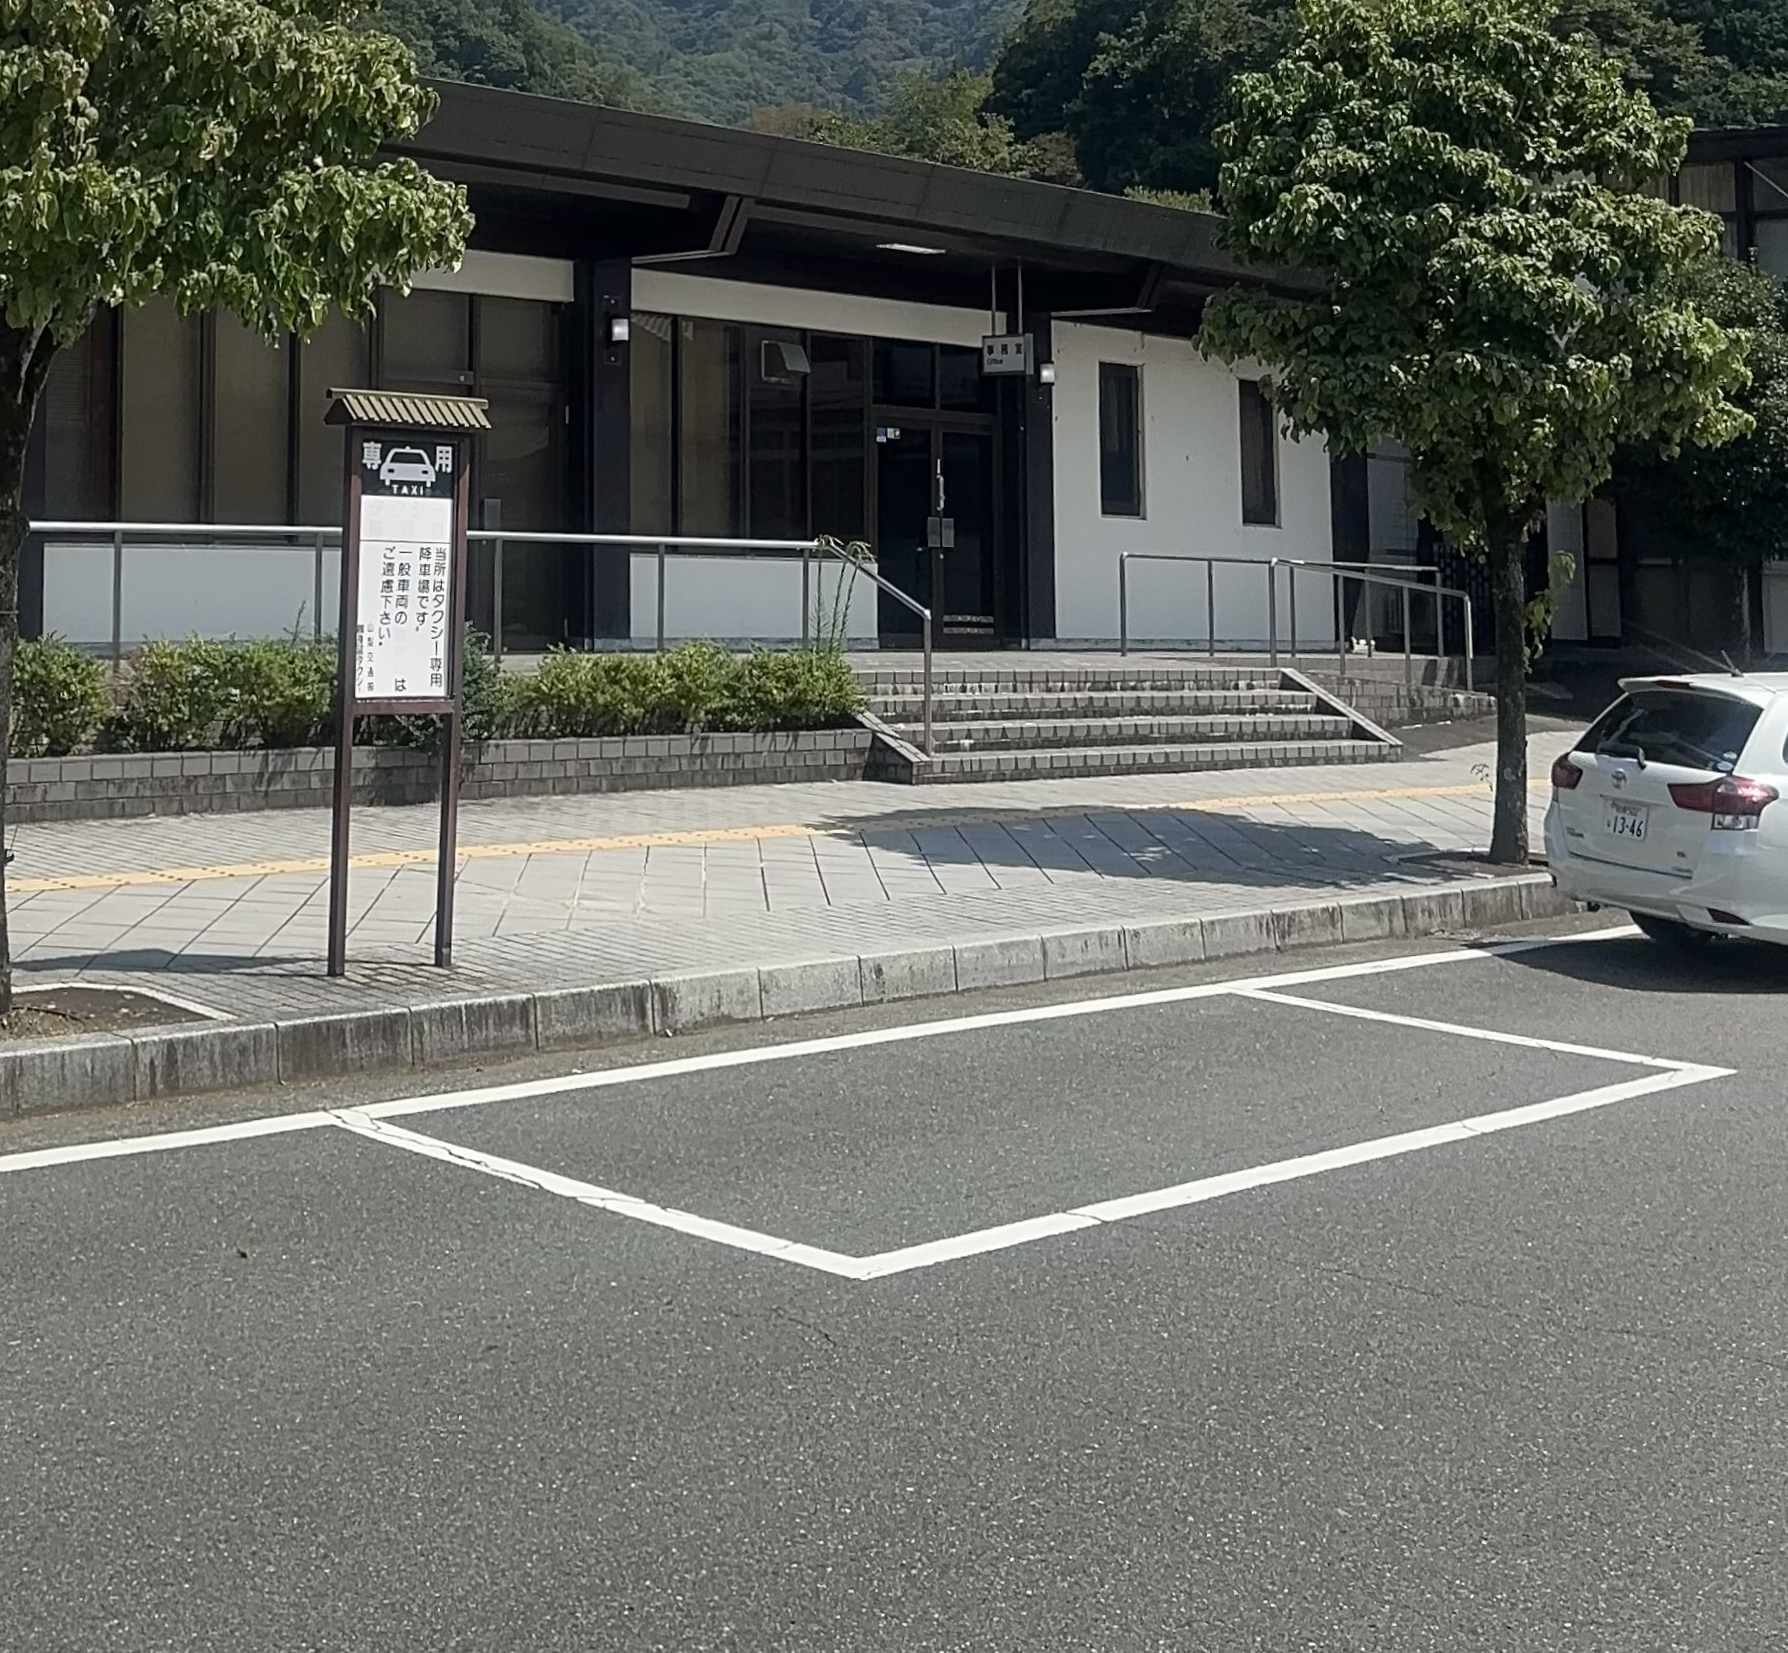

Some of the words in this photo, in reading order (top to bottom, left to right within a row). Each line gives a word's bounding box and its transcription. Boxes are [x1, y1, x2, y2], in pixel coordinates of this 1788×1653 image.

[362, 441, 382, 470] 専
[435, 446, 452, 473] 用
[392, 484, 423, 495] TAXI
[378, 546, 396, 646] ご遠慮下さい。
[416, 547, 432, 632] 降車場です。
[430, 547, 447, 688] 当所はタクシー専用
[1613, 815, 1644, 838] 13-46
